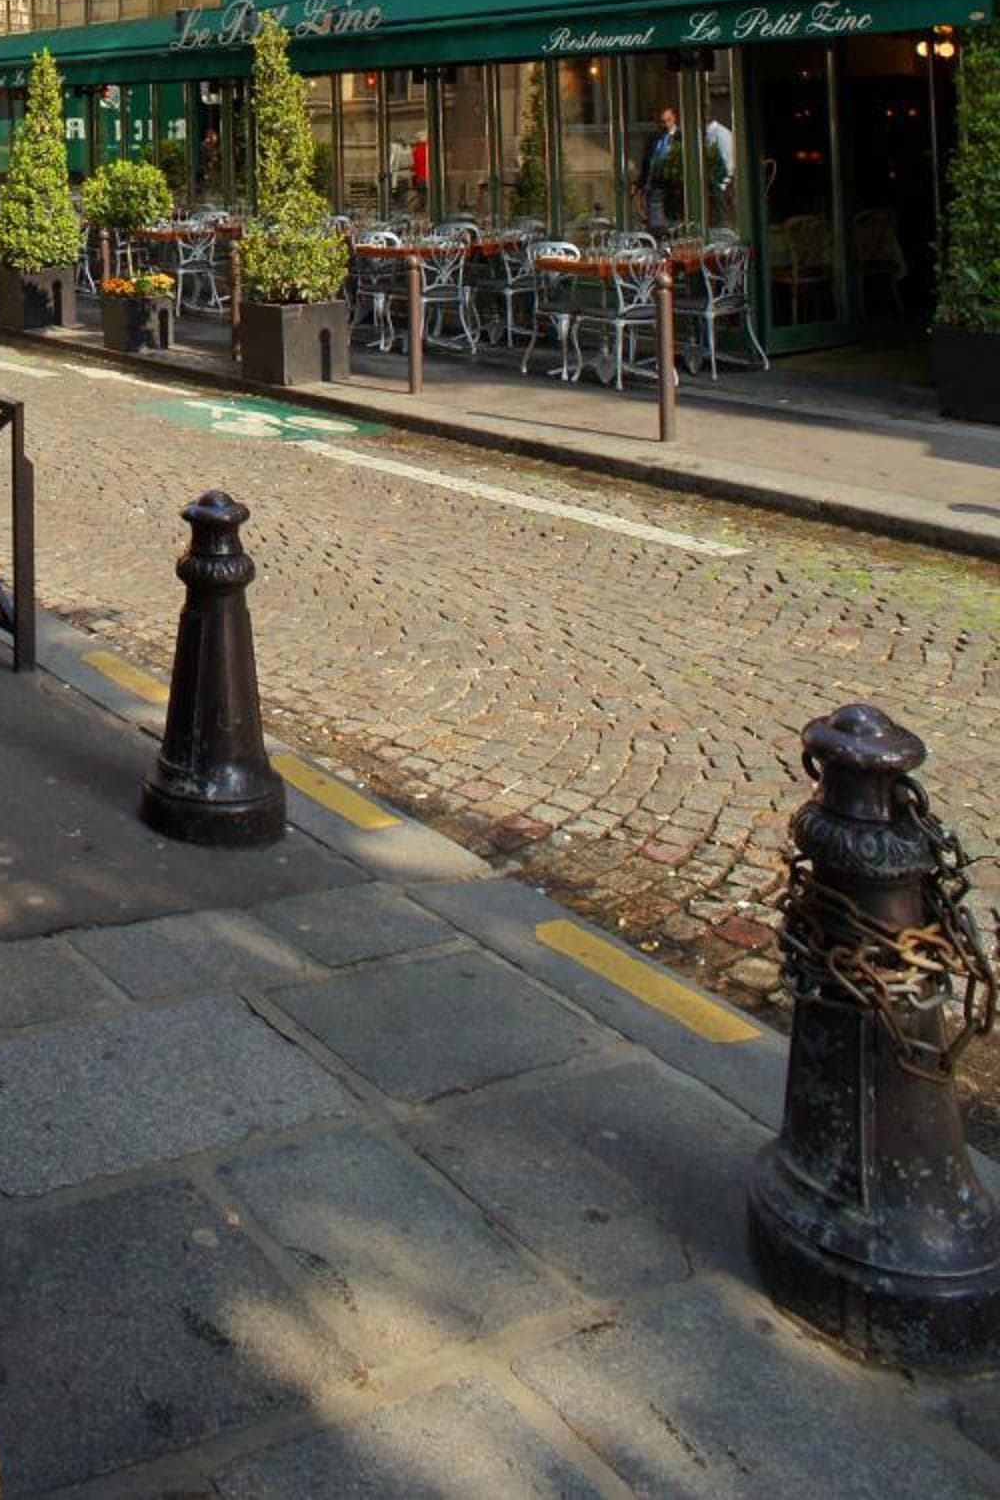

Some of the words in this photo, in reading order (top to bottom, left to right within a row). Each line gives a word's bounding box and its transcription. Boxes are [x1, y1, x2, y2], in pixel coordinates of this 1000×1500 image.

[170, 5, 213, 50] Le
[542, 26, 656, 52] Restaurant
[680, 10, 722, 44] Le
[732, 6, 802, 40] Petit
[805, 0, 873, 36] Zinc
